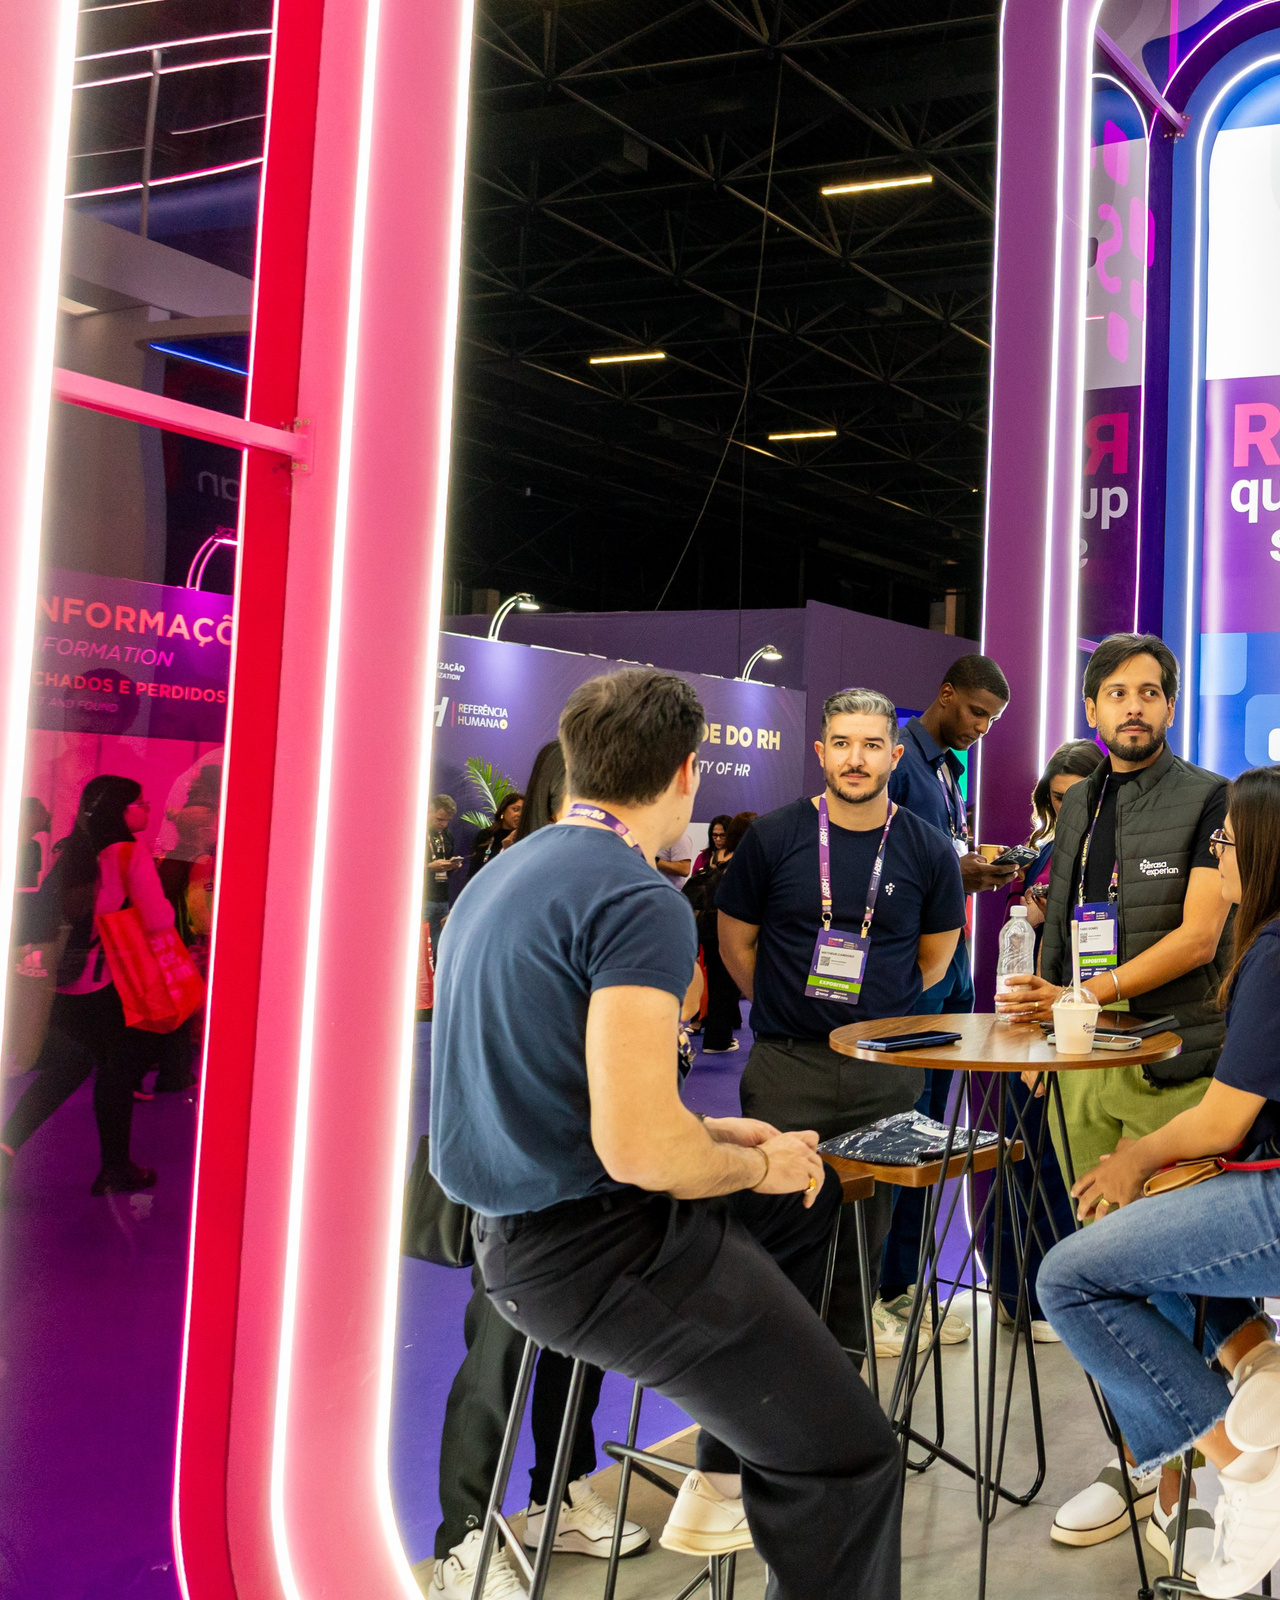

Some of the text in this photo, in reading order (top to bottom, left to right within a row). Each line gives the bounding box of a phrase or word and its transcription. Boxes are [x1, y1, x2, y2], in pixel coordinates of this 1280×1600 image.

[36, 596, 233, 648] NFORMAÇÕ
[43, 637, 175, 667] FORMATION
[33, 671, 227, 704] CHADOS E PERDIDOS
[458, 703, 508, 718] REFERÊNCIA
[457, 715, 499, 729] HUMANA
[726, 724, 753, 748] DO
[756, 728, 781, 751] RH
[715, 761, 733, 775] OF
[733, 763, 751, 777] HR
[819, 979, 850, 990] EXPOSITOR
